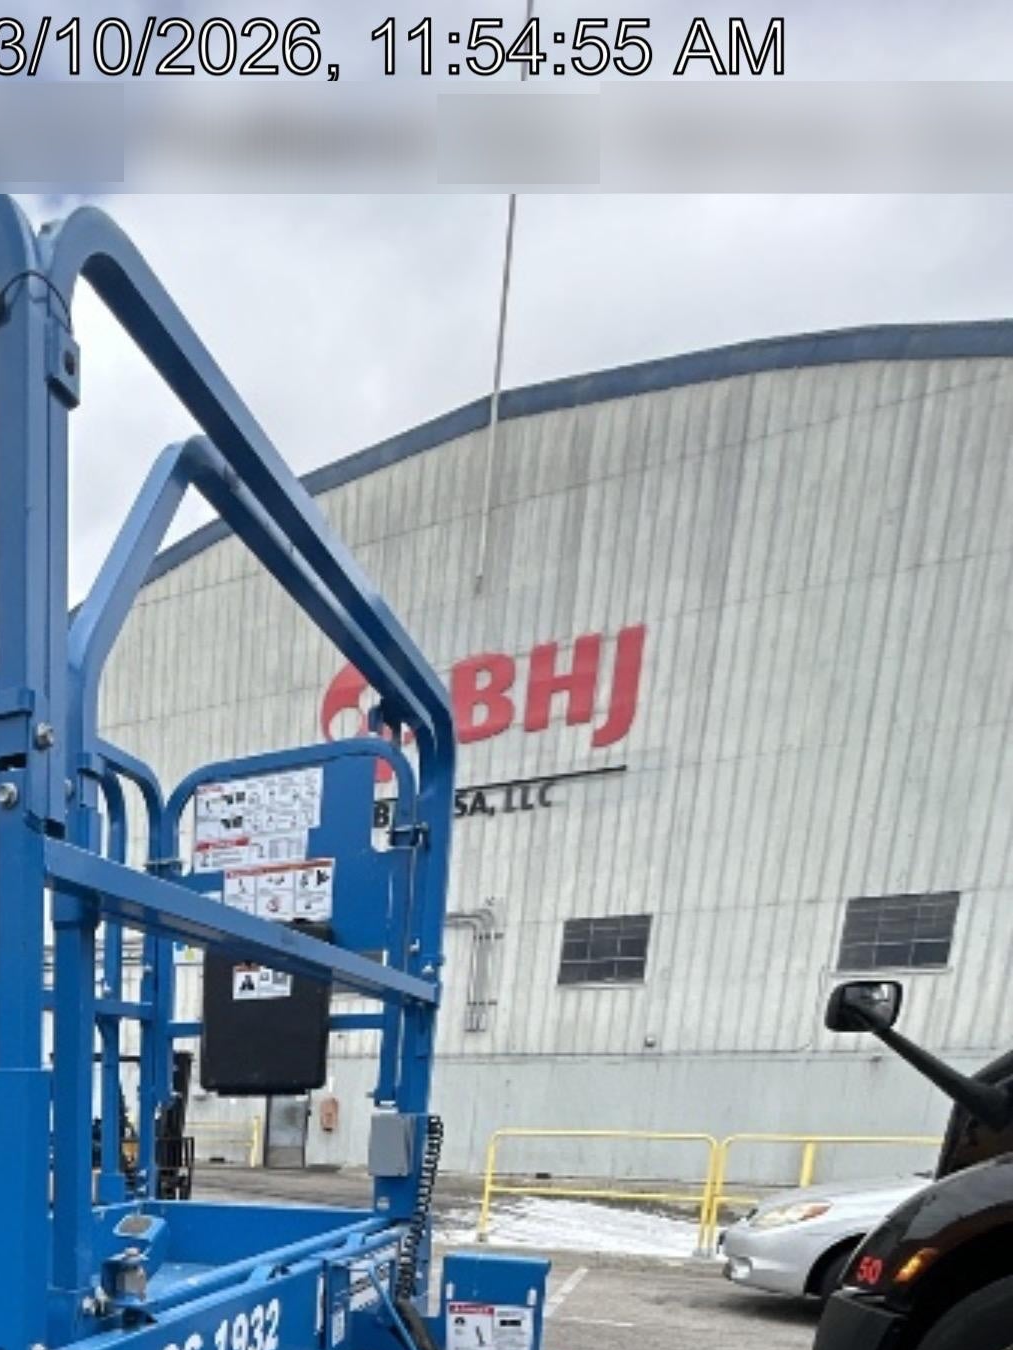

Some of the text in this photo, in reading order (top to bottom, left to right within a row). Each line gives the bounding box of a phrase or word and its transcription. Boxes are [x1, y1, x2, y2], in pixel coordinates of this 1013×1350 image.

[451, 624, 646, 748] BHJ
[453, 789, 495, 819] SA,
[857, 1255, 883, 1285] 50
